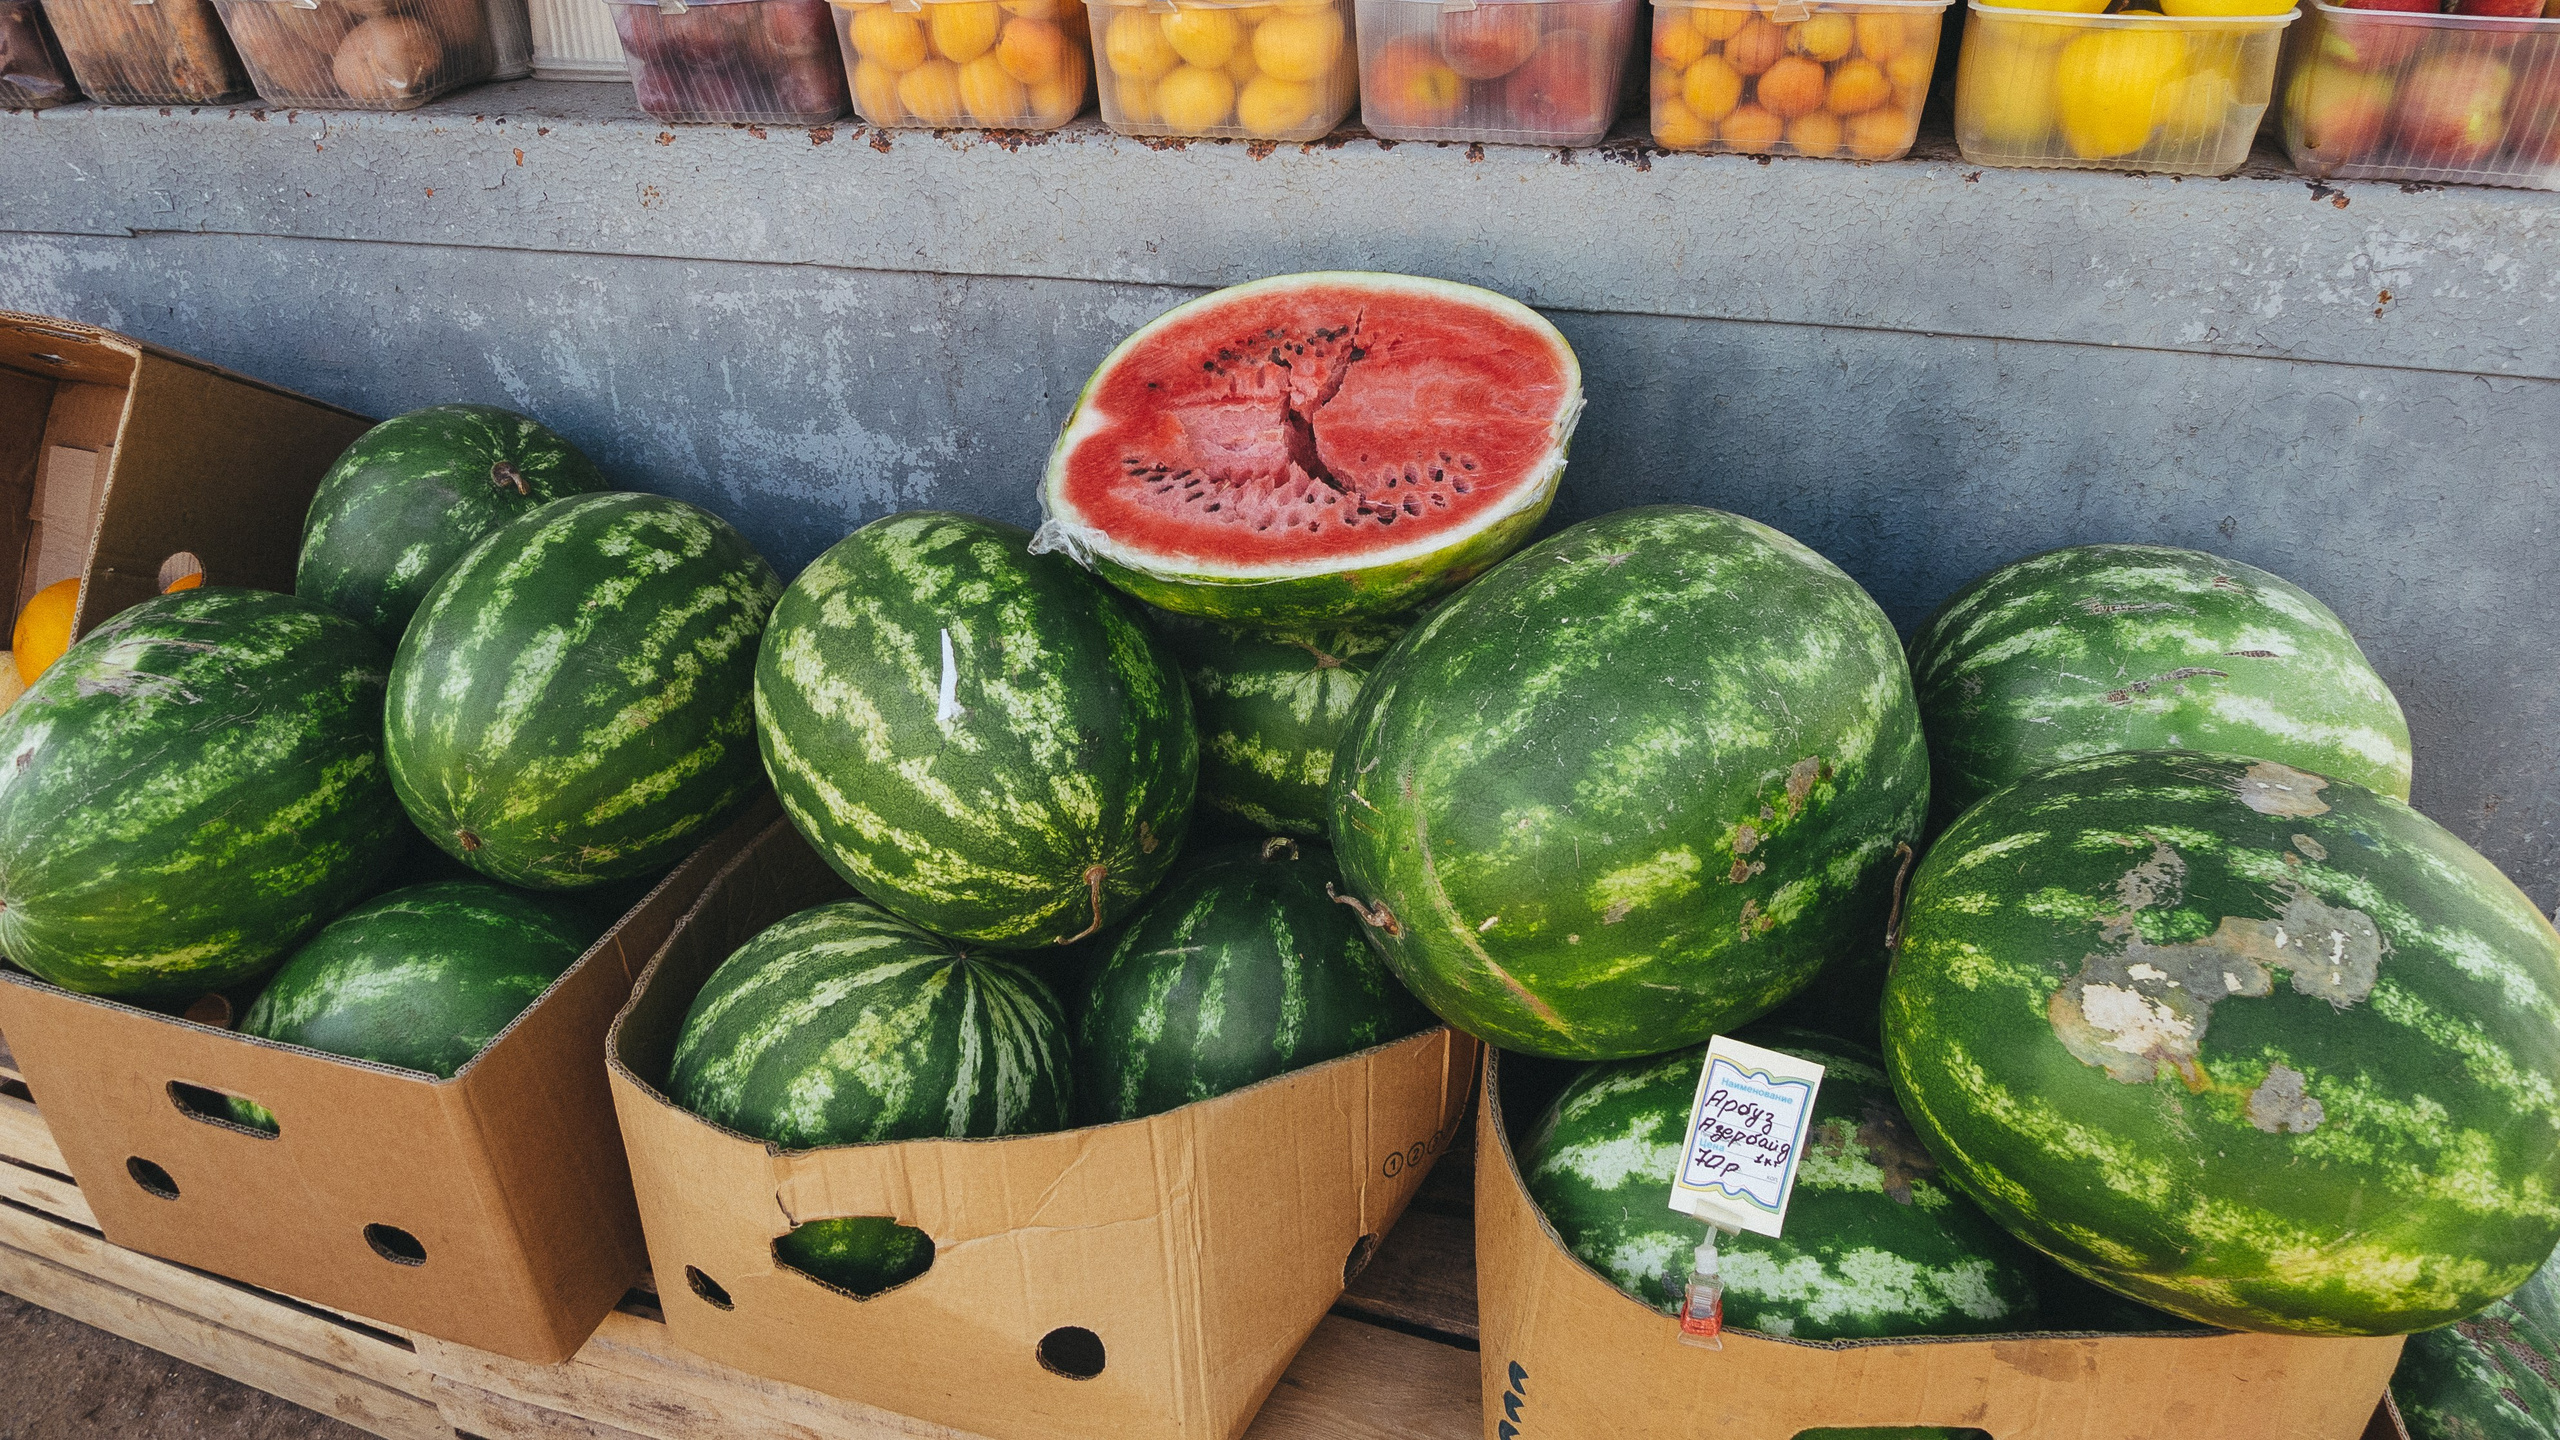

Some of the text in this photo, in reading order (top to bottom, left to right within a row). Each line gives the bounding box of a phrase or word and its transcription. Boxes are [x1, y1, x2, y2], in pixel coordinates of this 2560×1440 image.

[1721, 1077, 1793, 1104] Наименование
[1705, 1090, 1774, 1135] Арбуз
[1699, 1138, 1725, 1153] Цена
